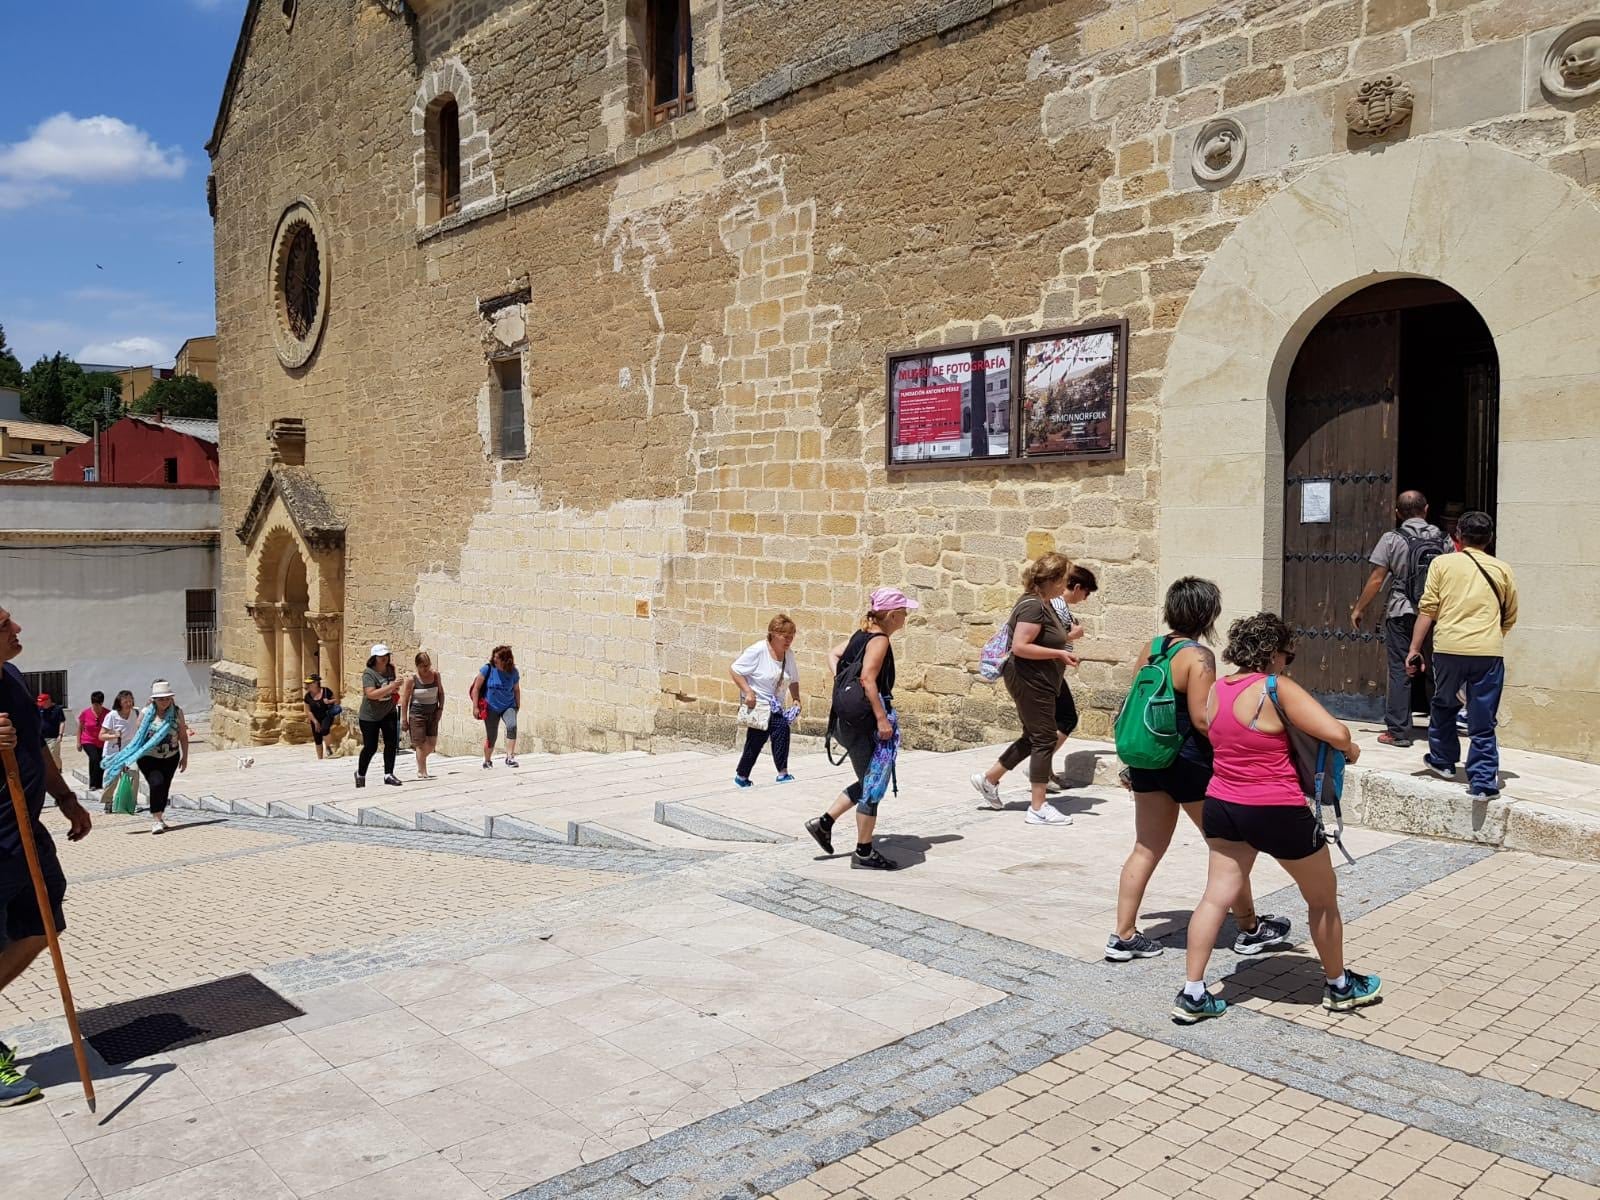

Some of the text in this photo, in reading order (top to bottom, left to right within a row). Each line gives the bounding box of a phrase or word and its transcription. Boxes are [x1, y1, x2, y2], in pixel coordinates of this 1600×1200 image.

[898, 355, 1006, 380] MUSEO DE FOTOGRAFÍA
